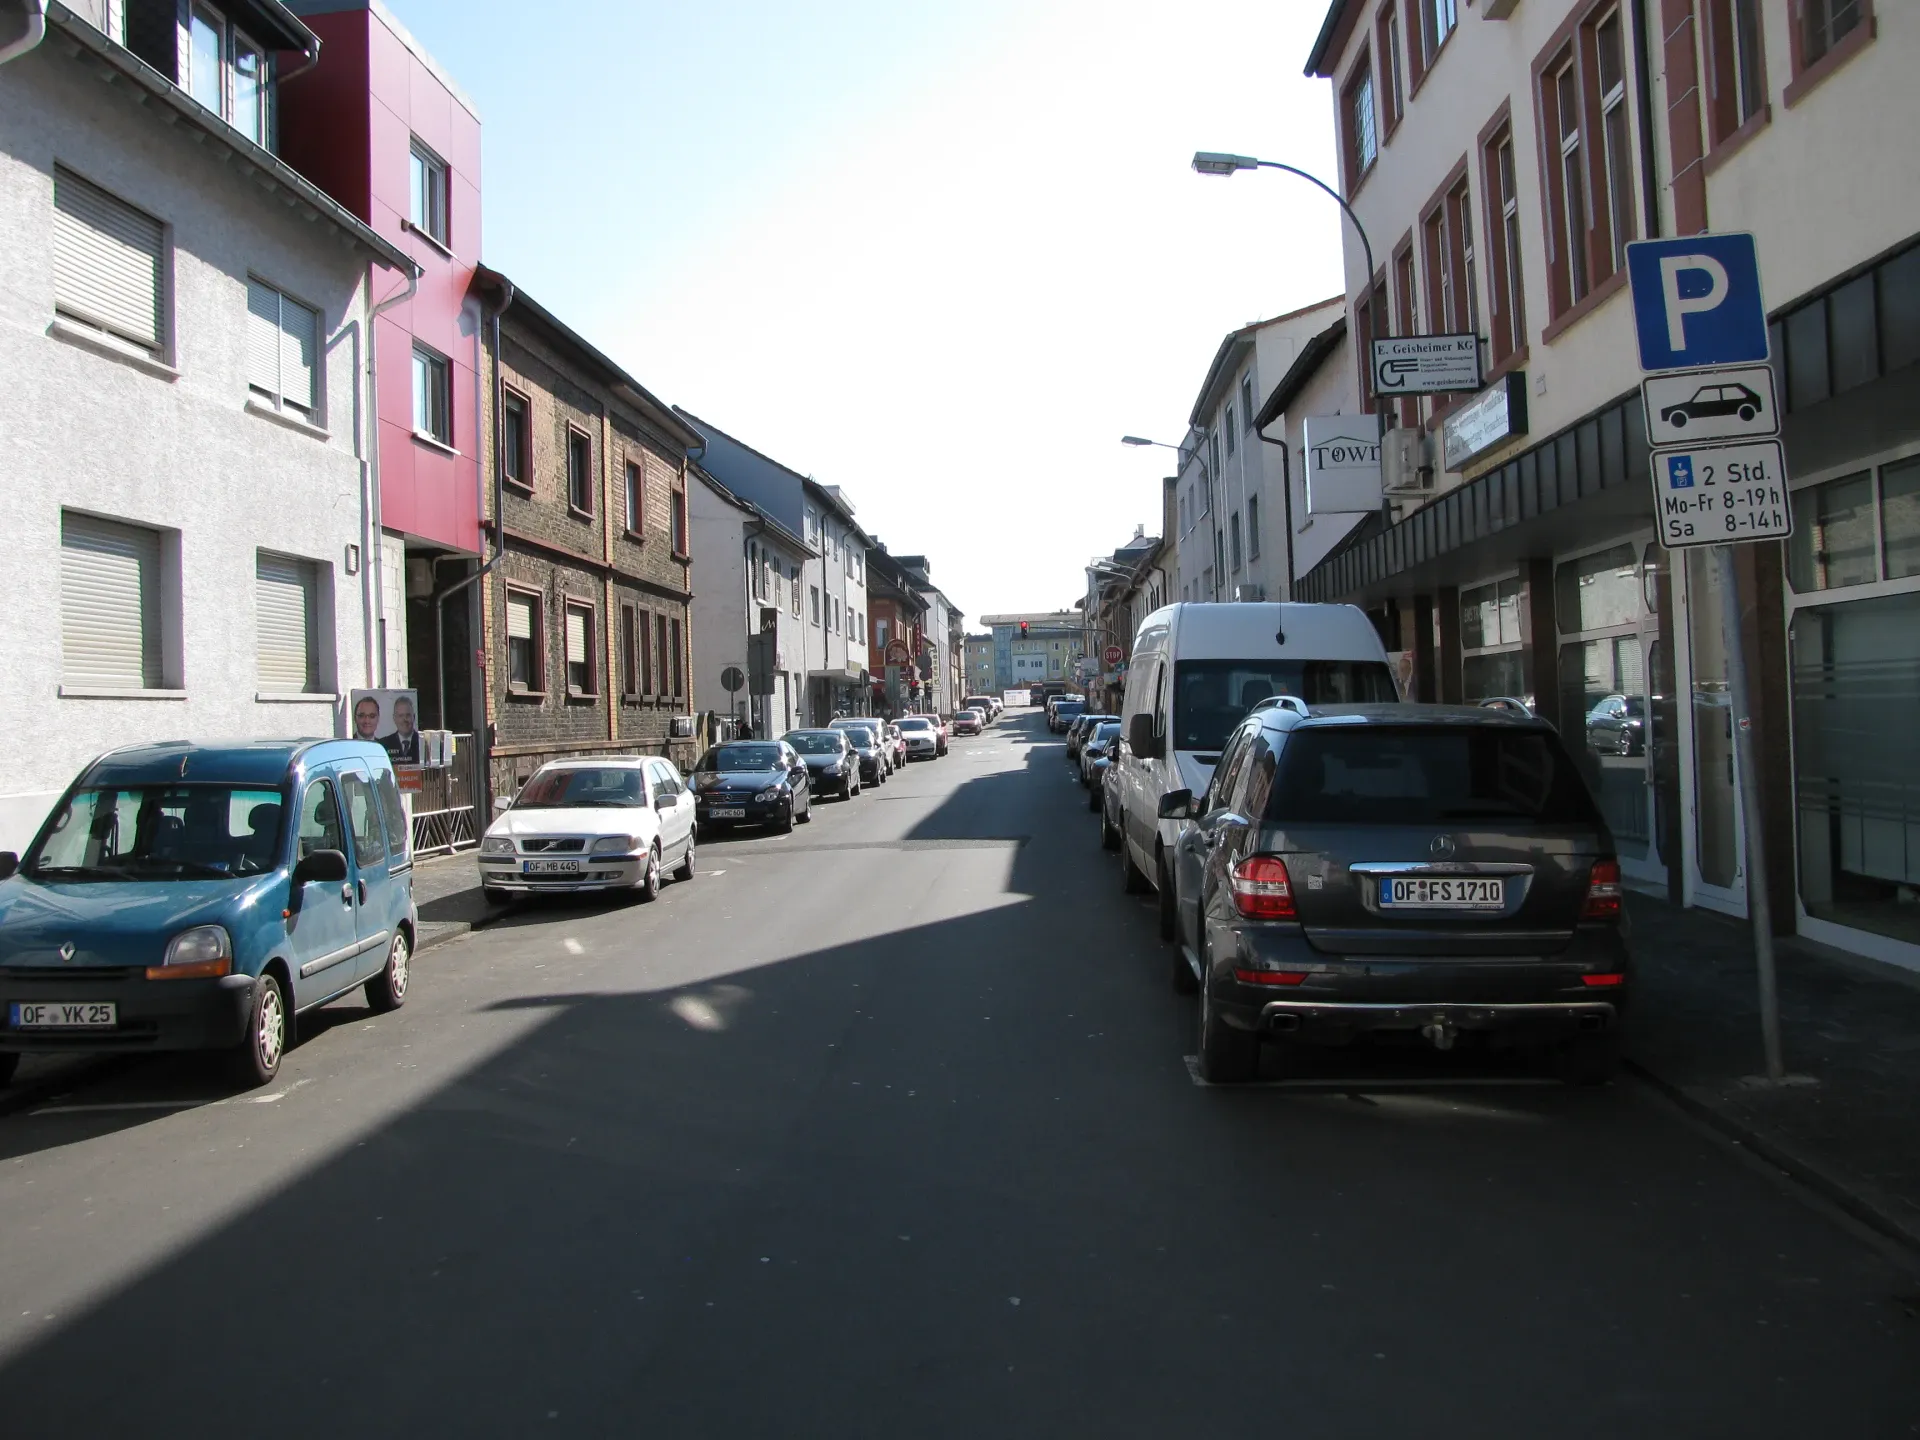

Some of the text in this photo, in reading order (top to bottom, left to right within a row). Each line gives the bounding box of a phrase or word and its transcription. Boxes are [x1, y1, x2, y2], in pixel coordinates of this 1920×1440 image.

[1659, 254, 1729, 352] P
[1377, 340, 1474, 355] E. Geisheimer KG
[1422, 378, 1477, 386] www.geisheimer.de
[1702, 461, 1771, 486] 2 Std.
[1665, 493, 1714, 515] Mo-Fr
[1669, 520, 1694, 538] Sa
[1105, 651, 1121, 659] STOP
[529, 861, 577, 871] OF MB 445
[1394, 881, 1500, 901] OF FS 1710
[23, 1005, 111, 1023] OF YK 25
